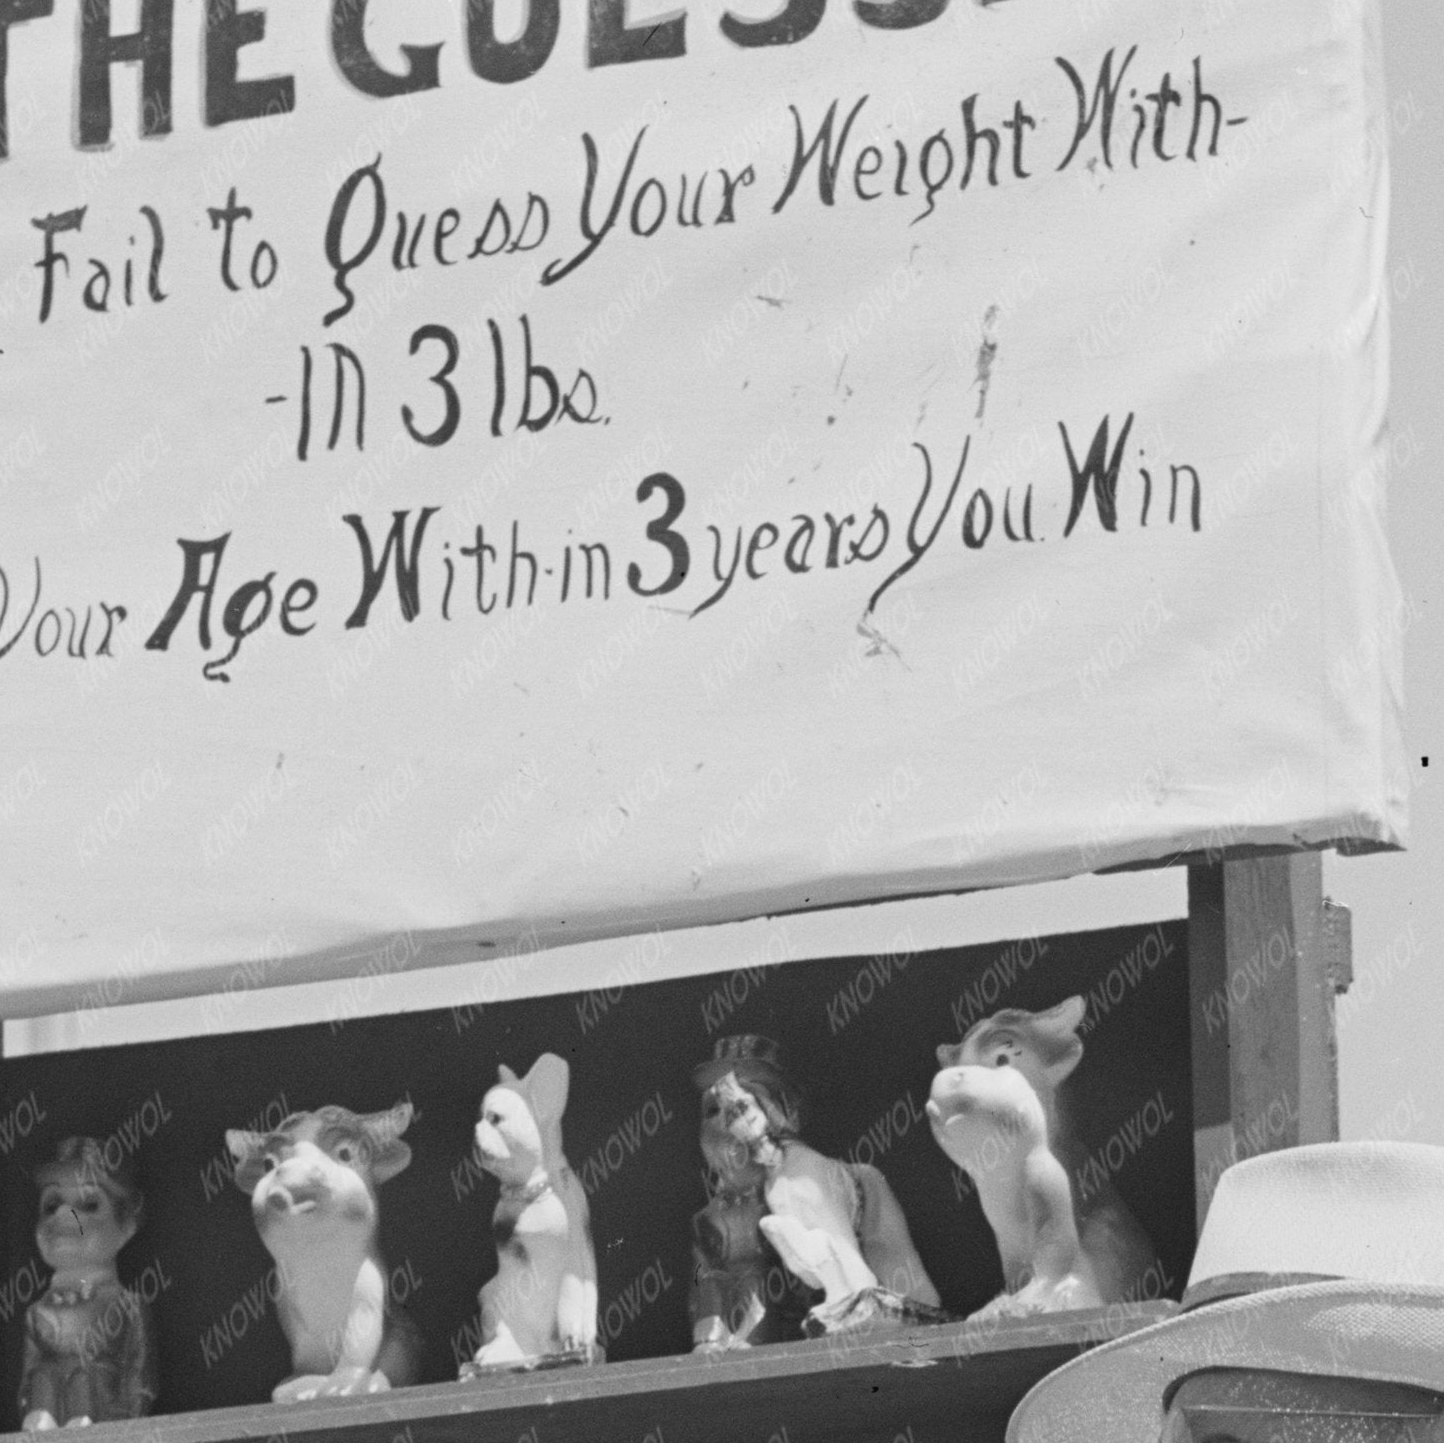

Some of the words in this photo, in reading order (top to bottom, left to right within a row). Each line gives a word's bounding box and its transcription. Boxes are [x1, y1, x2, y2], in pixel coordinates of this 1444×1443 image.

[31, 205, 168, 324] Fail
[206, 187, 278, 292] to
[540, 124, 756, 287] Your
[771, 93, 1037, 226] Weight
[401, 323, 462, 448] 3
[144, 531, 319, 684] Age
[627, 472, 691, 597] 3
[688, 503, 890, 619] years
[1058, 411, 1202, 539] Win
